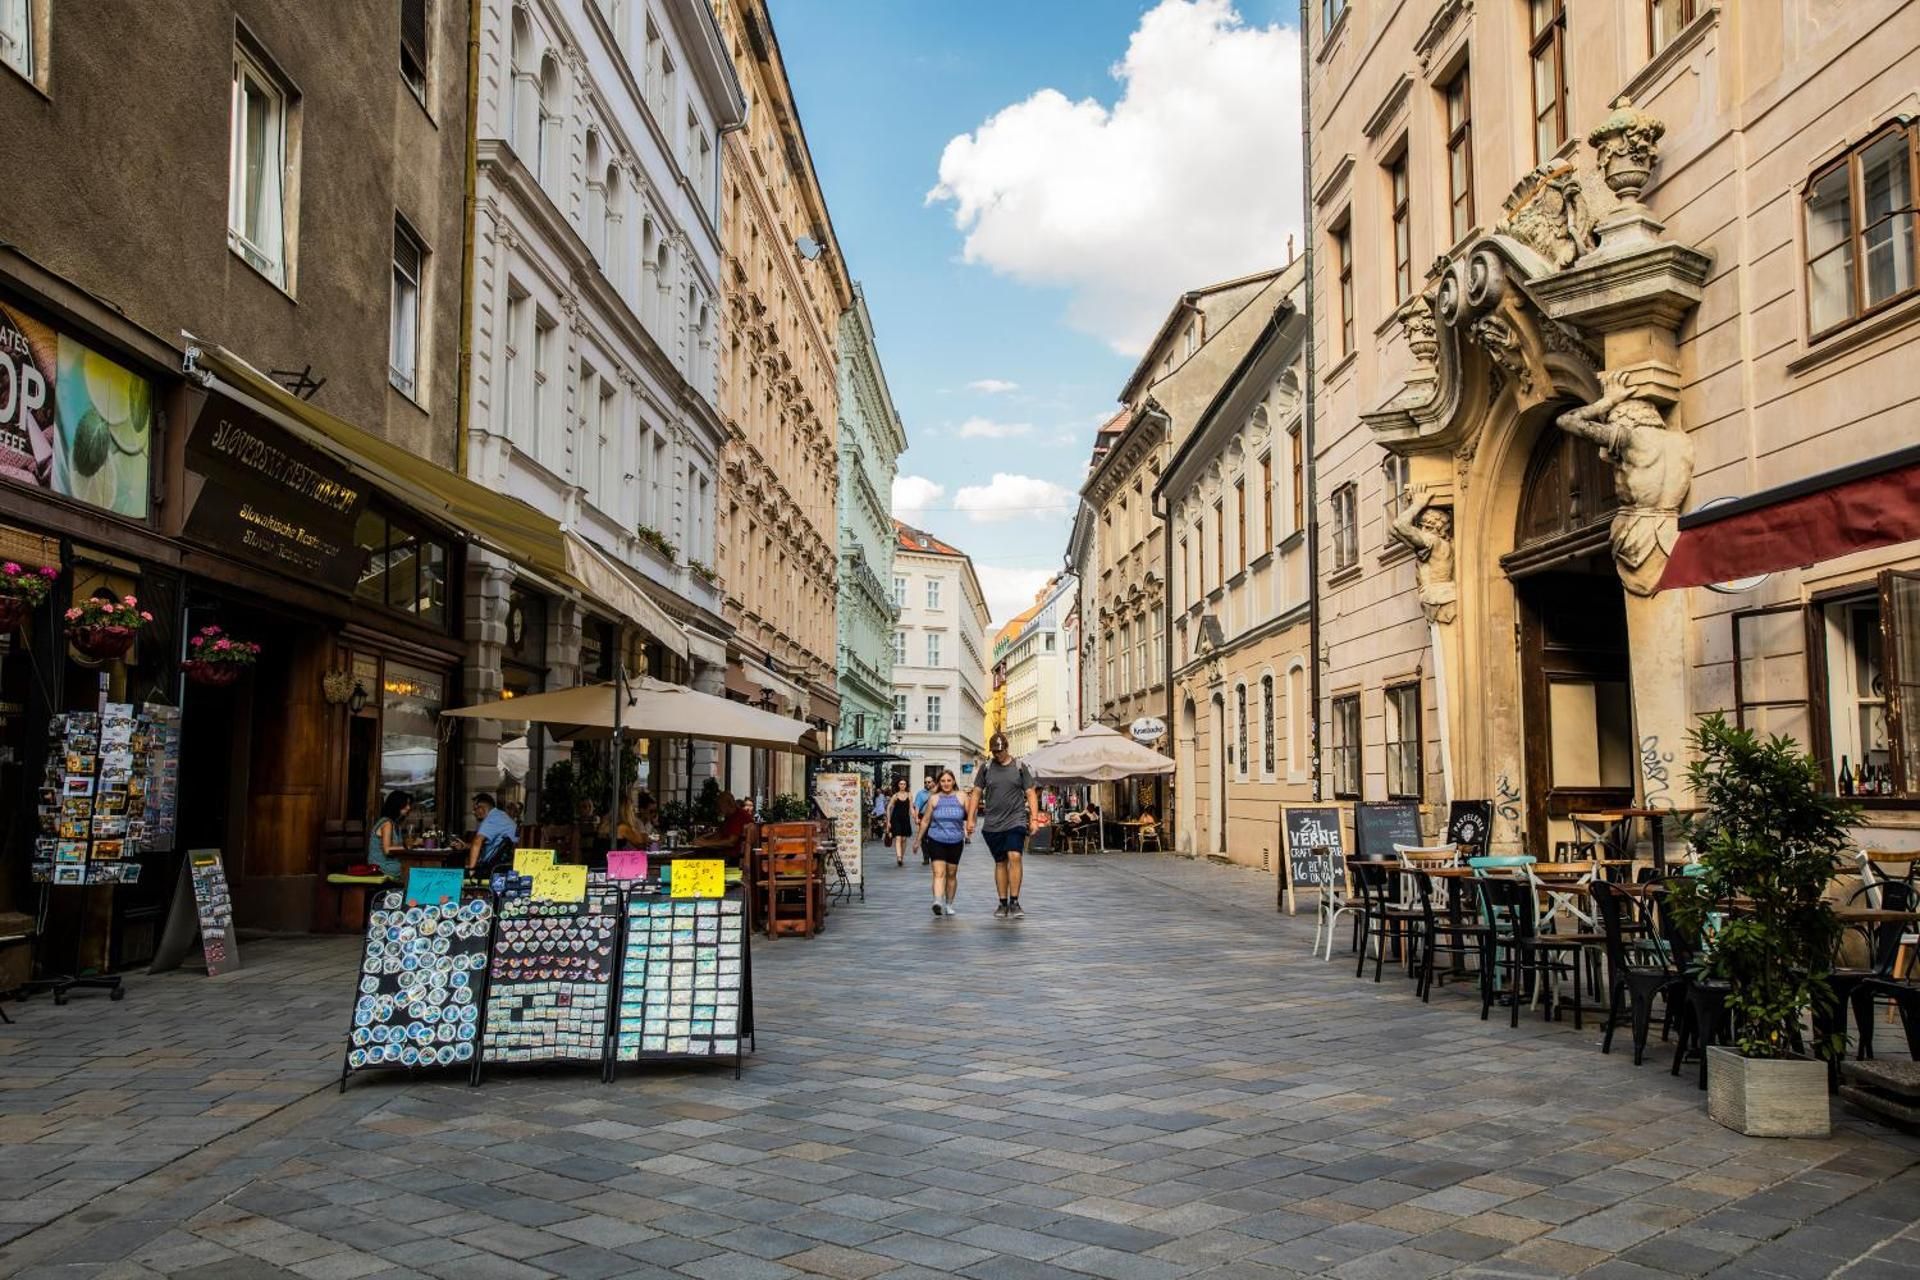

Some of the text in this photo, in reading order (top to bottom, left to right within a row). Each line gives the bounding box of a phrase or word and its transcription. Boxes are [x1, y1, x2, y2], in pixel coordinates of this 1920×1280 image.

[0, 325, 29, 355] ATES
[1289, 830, 1339, 847] VERNE
[1291, 857, 1330, 881] 16 BER
